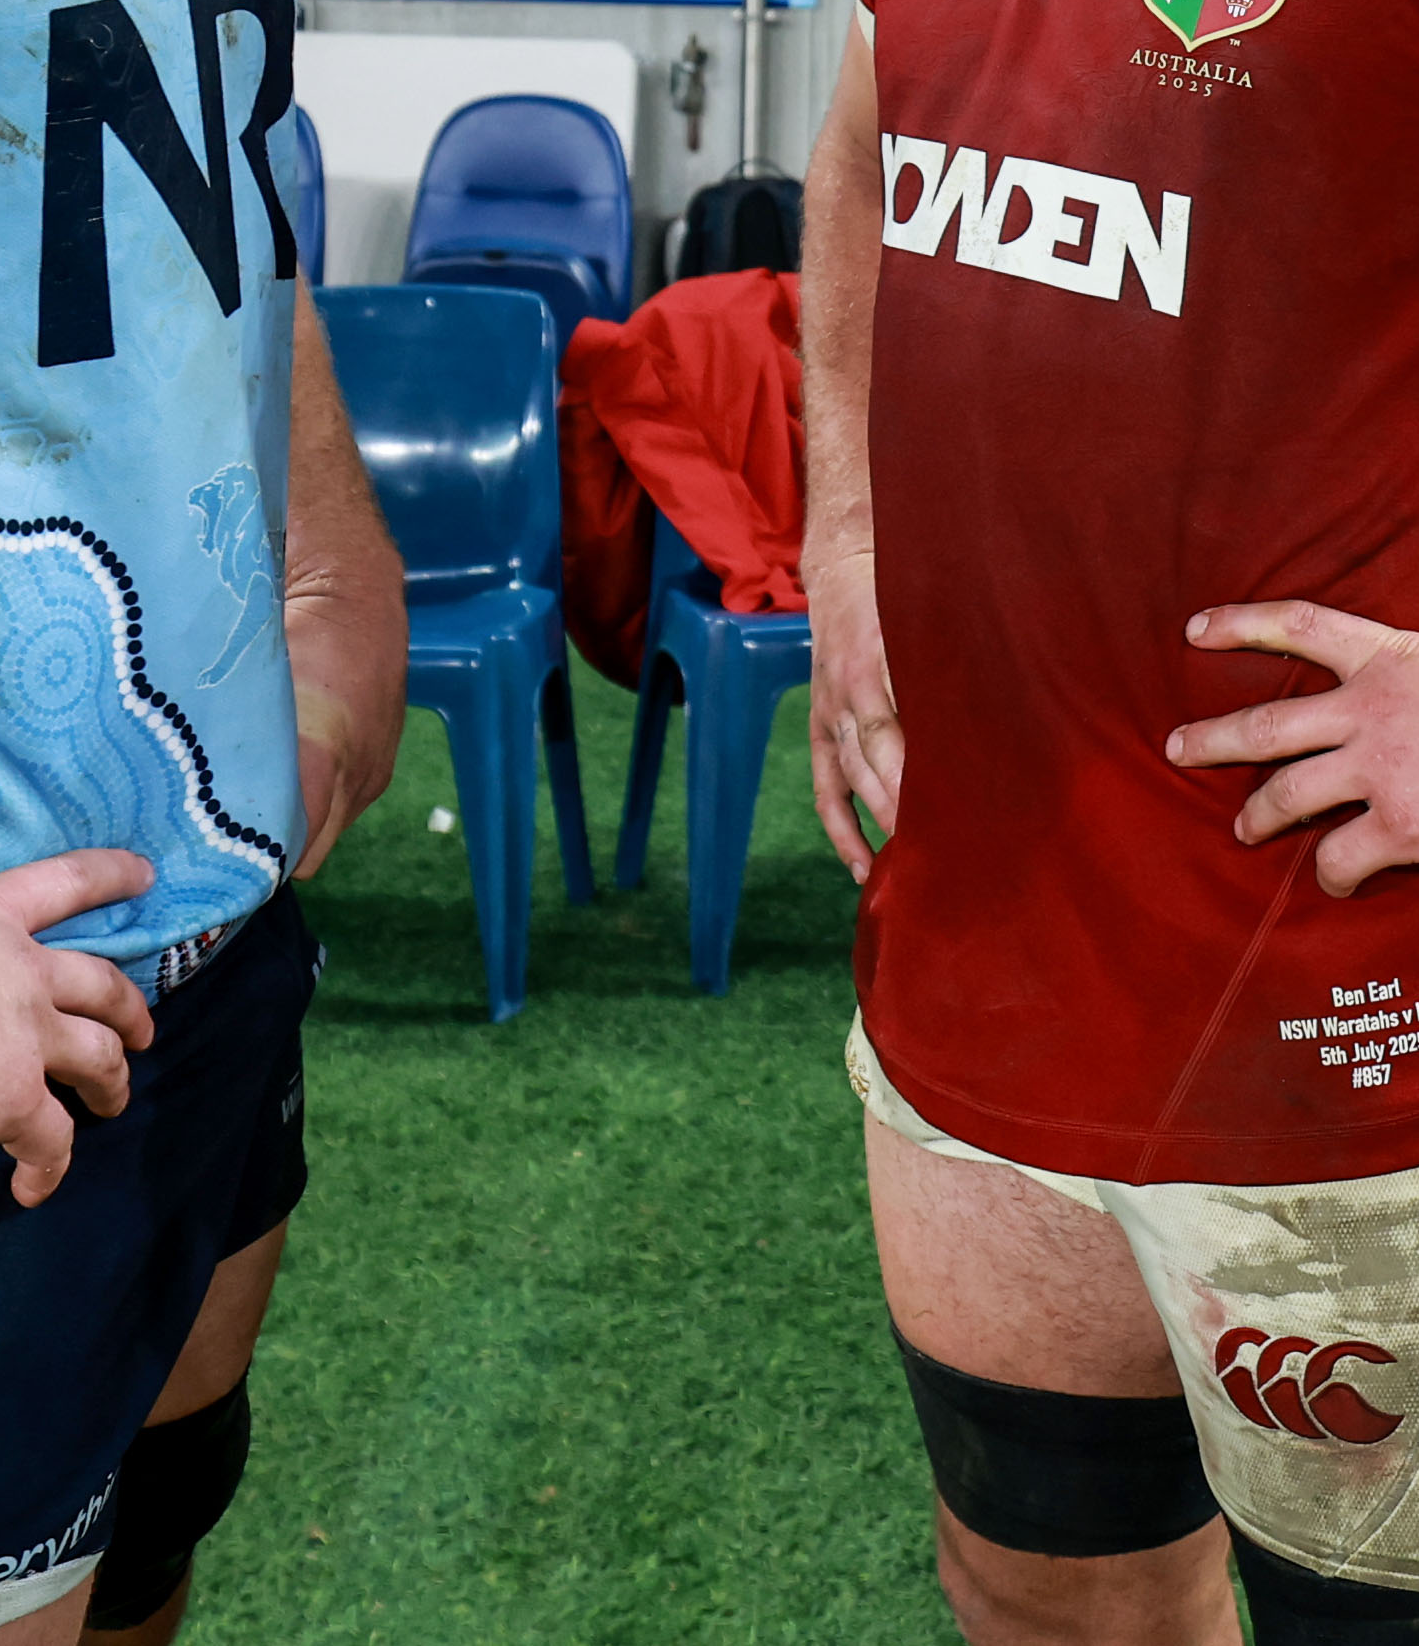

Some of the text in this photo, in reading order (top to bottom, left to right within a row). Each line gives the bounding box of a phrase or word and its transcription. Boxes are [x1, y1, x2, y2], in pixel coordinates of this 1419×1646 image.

[1129, 48, 1253, 89] AUSTRALIA
[1158, 74, 1213, 97] 2025
[881, 132, 1192, 317] OWDEN
[1331, 977, 1402, 1008] Ben Earl
[1279, 1018, 1318, 1041] NSW
[1321, 1010, 1400, 1038] Waratahs
[1402, 1008, 1413, 1025] v
[1319, 1045, 1348, 1066] 5th
[1351, 1040, 1385, 1063] July
[1352, 1063, 1392, 1089] #857
